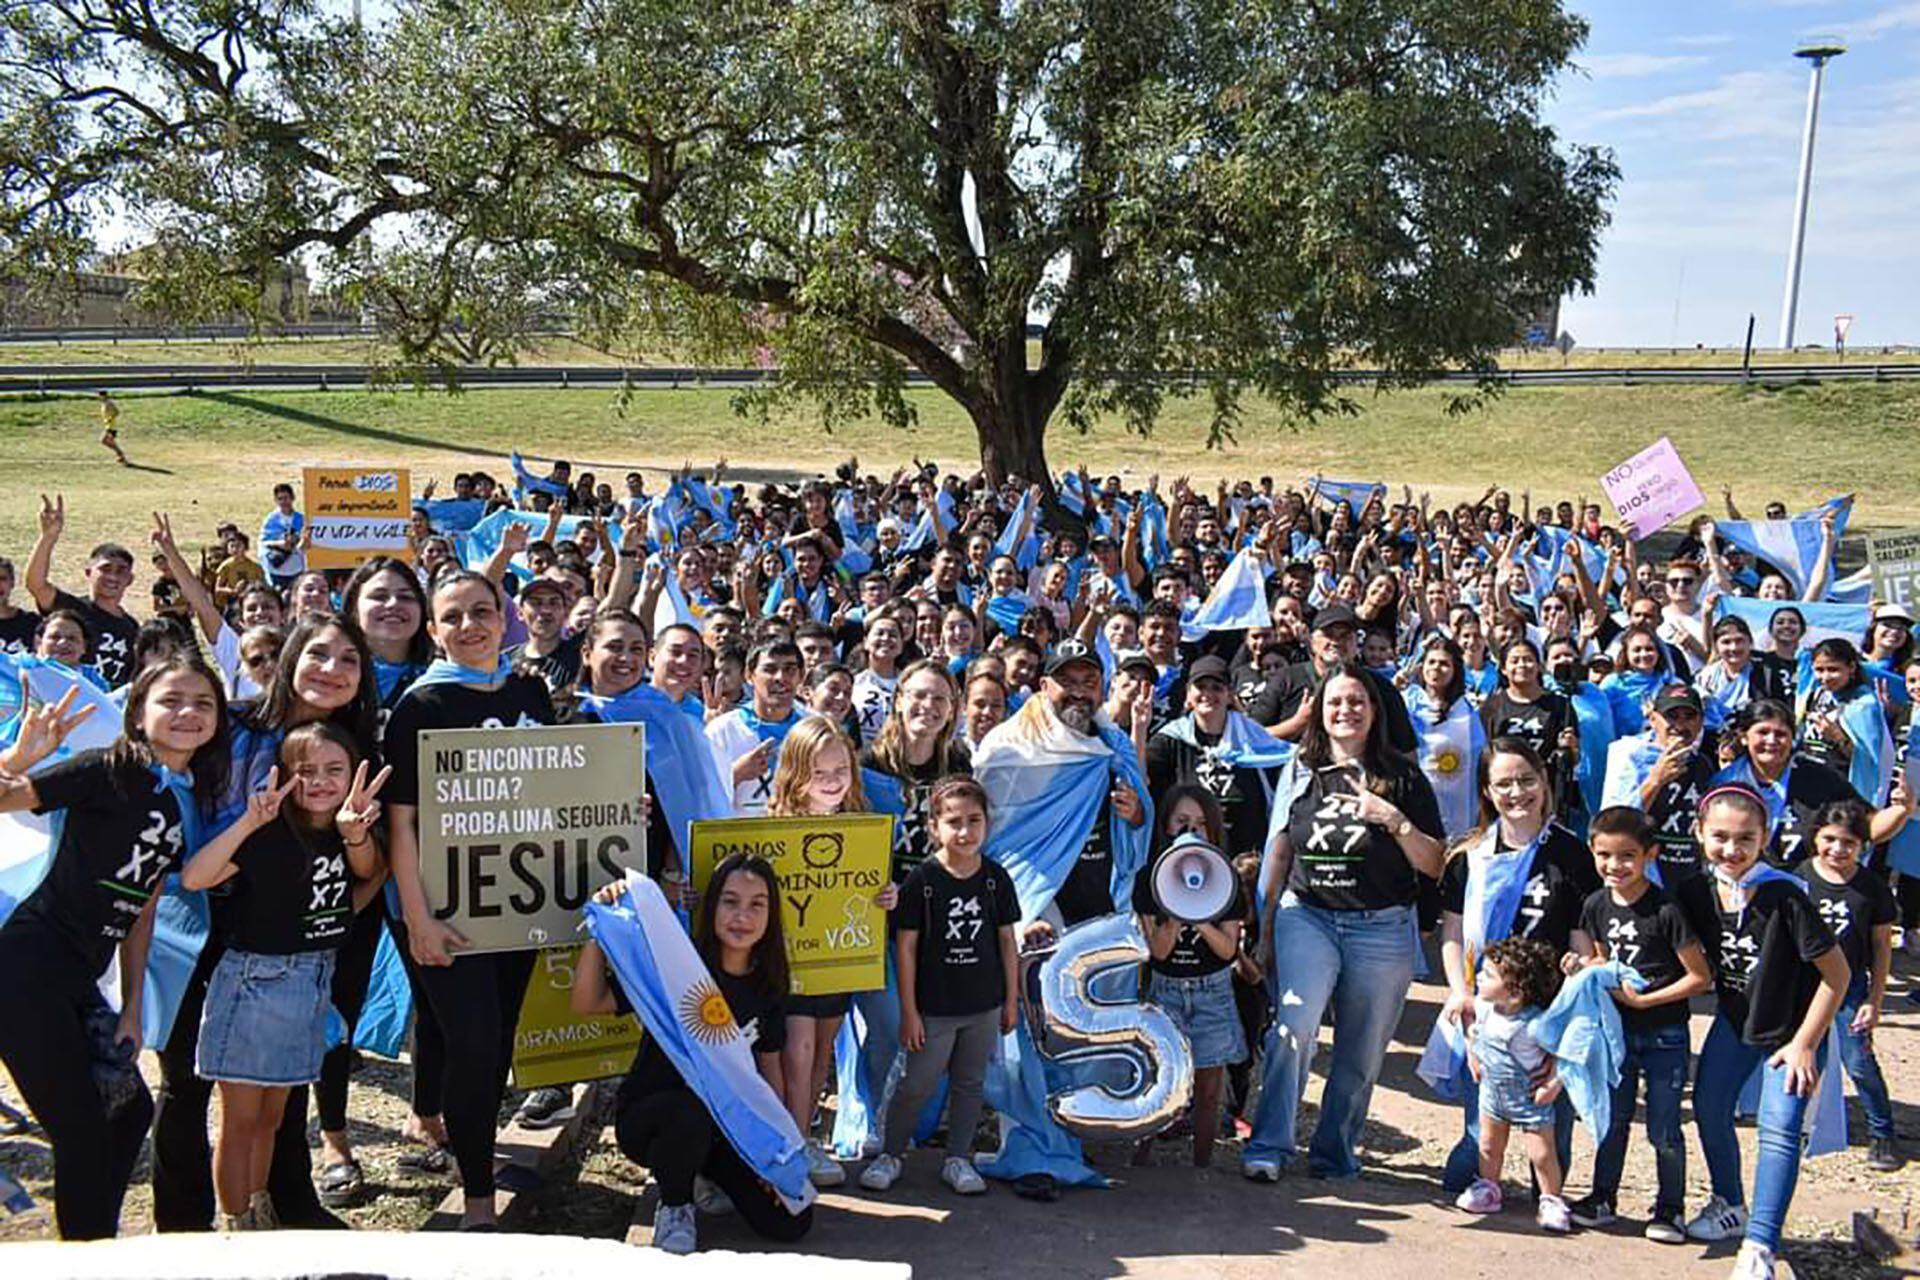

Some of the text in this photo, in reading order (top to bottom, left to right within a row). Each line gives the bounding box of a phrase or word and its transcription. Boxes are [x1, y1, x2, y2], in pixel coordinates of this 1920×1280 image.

[1605, 463, 1633, 488] NO
[1618, 491, 1650, 516] DIOS
[99, 632, 128, 656] 24
[1507, 716, 1543, 735] 24
[436, 745, 586, 774] NO ENCONTRAS
[436, 776, 523, 803] SALIDA?
[140, 810, 183, 854] 24
[441, 803, 638, 836] PROBA UNA SEGURA.
[312, 853, 345, 880] 24
[434, 834, 629, 921] JESUS
[776, 869, 880, 892] MINUTOS
[787, 894, 814, 928] Y
[949, 896, 982, 917] 24
[1819, 898, 1849, 917] 24
[796, 923, 872, 951] POR VOS
[1607, 917, 1639, 941] 24
[1721, 931, 1758, 953] 24
[546, 953, 574, 989] 5
[607, 1024, 628, 1036] POR
